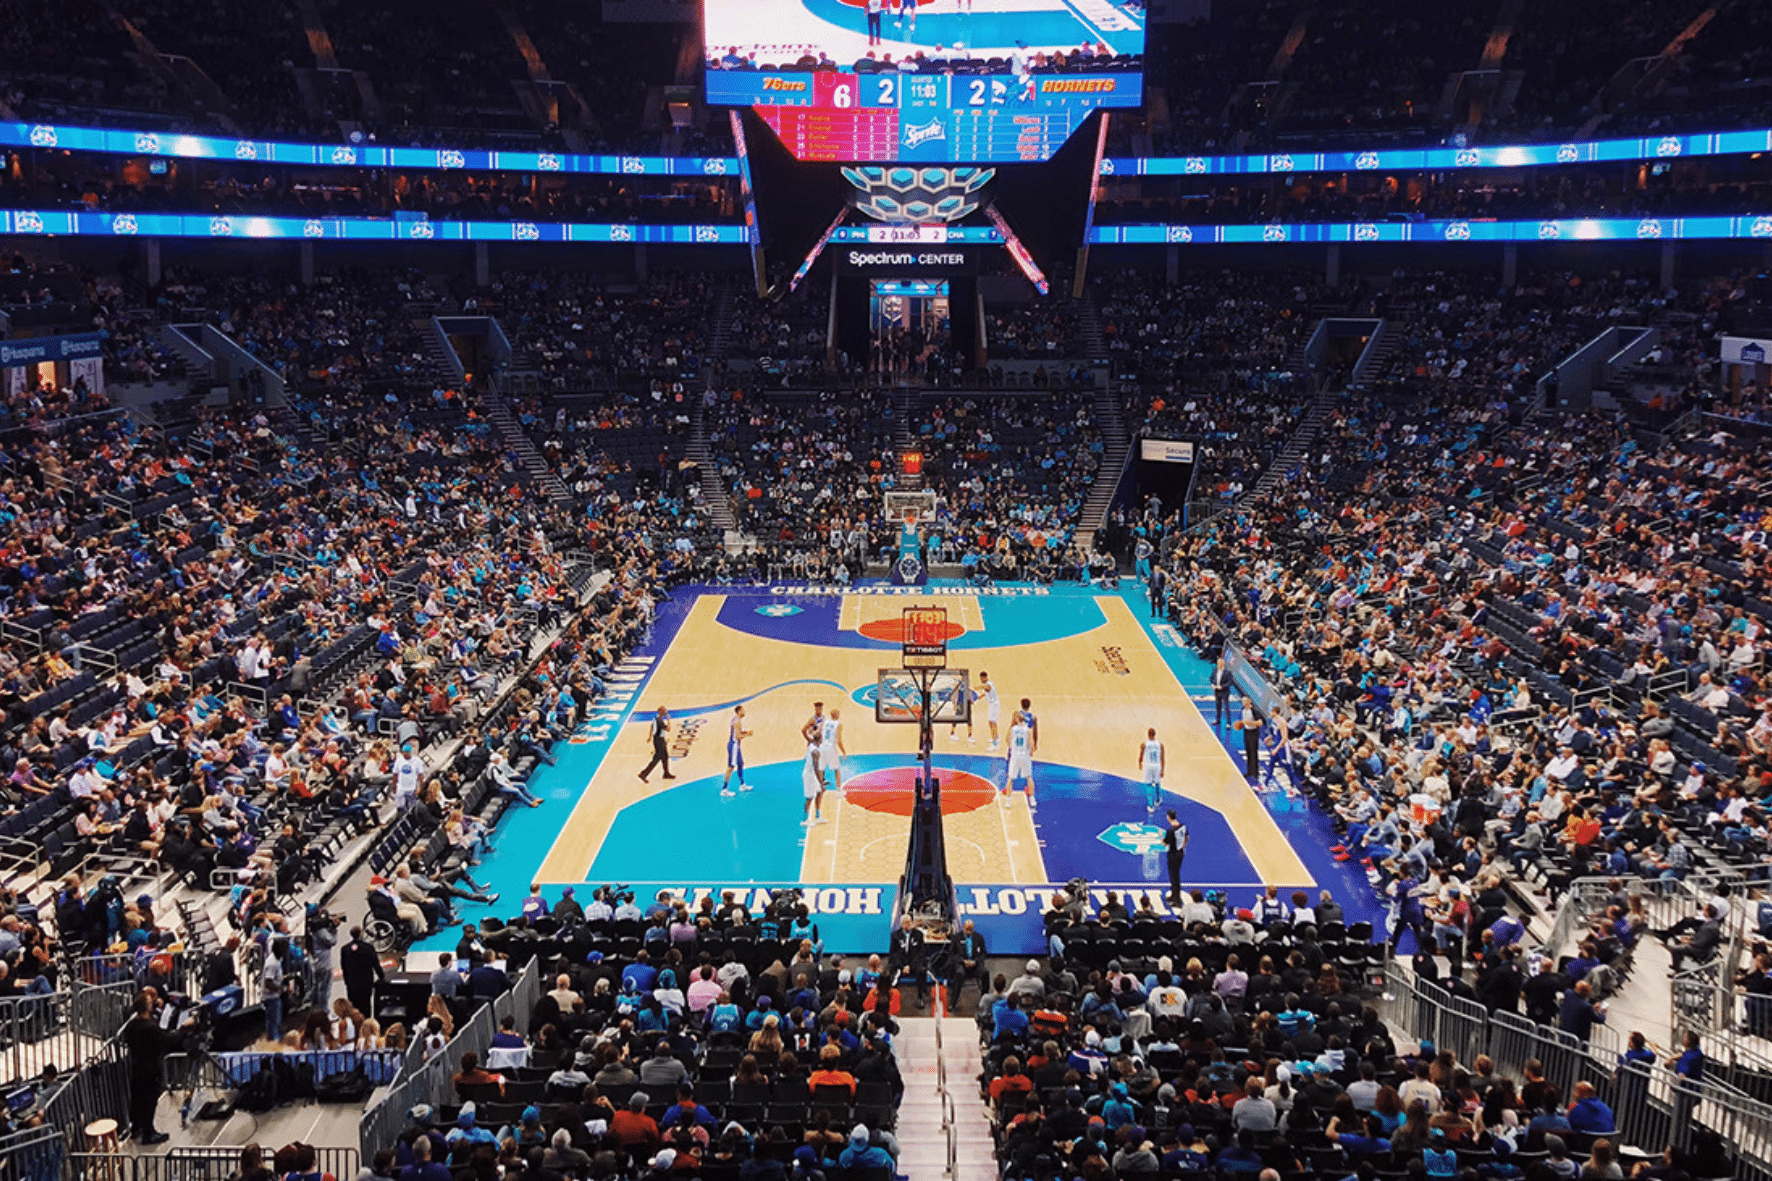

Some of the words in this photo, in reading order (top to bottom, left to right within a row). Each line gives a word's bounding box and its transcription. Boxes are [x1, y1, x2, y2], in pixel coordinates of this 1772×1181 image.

[878, 79, 894, 104] 2
[969, 80, 985, 105] 2
[1042, 78, 1116, 92] HORNETS
[849, 252, 912, 267] Spectrum
[918, 254, 964, 265] CENTER
[770, 586, 923, 595] CHARLOTTE
[932, 587, 1050, 595] HORNETS
